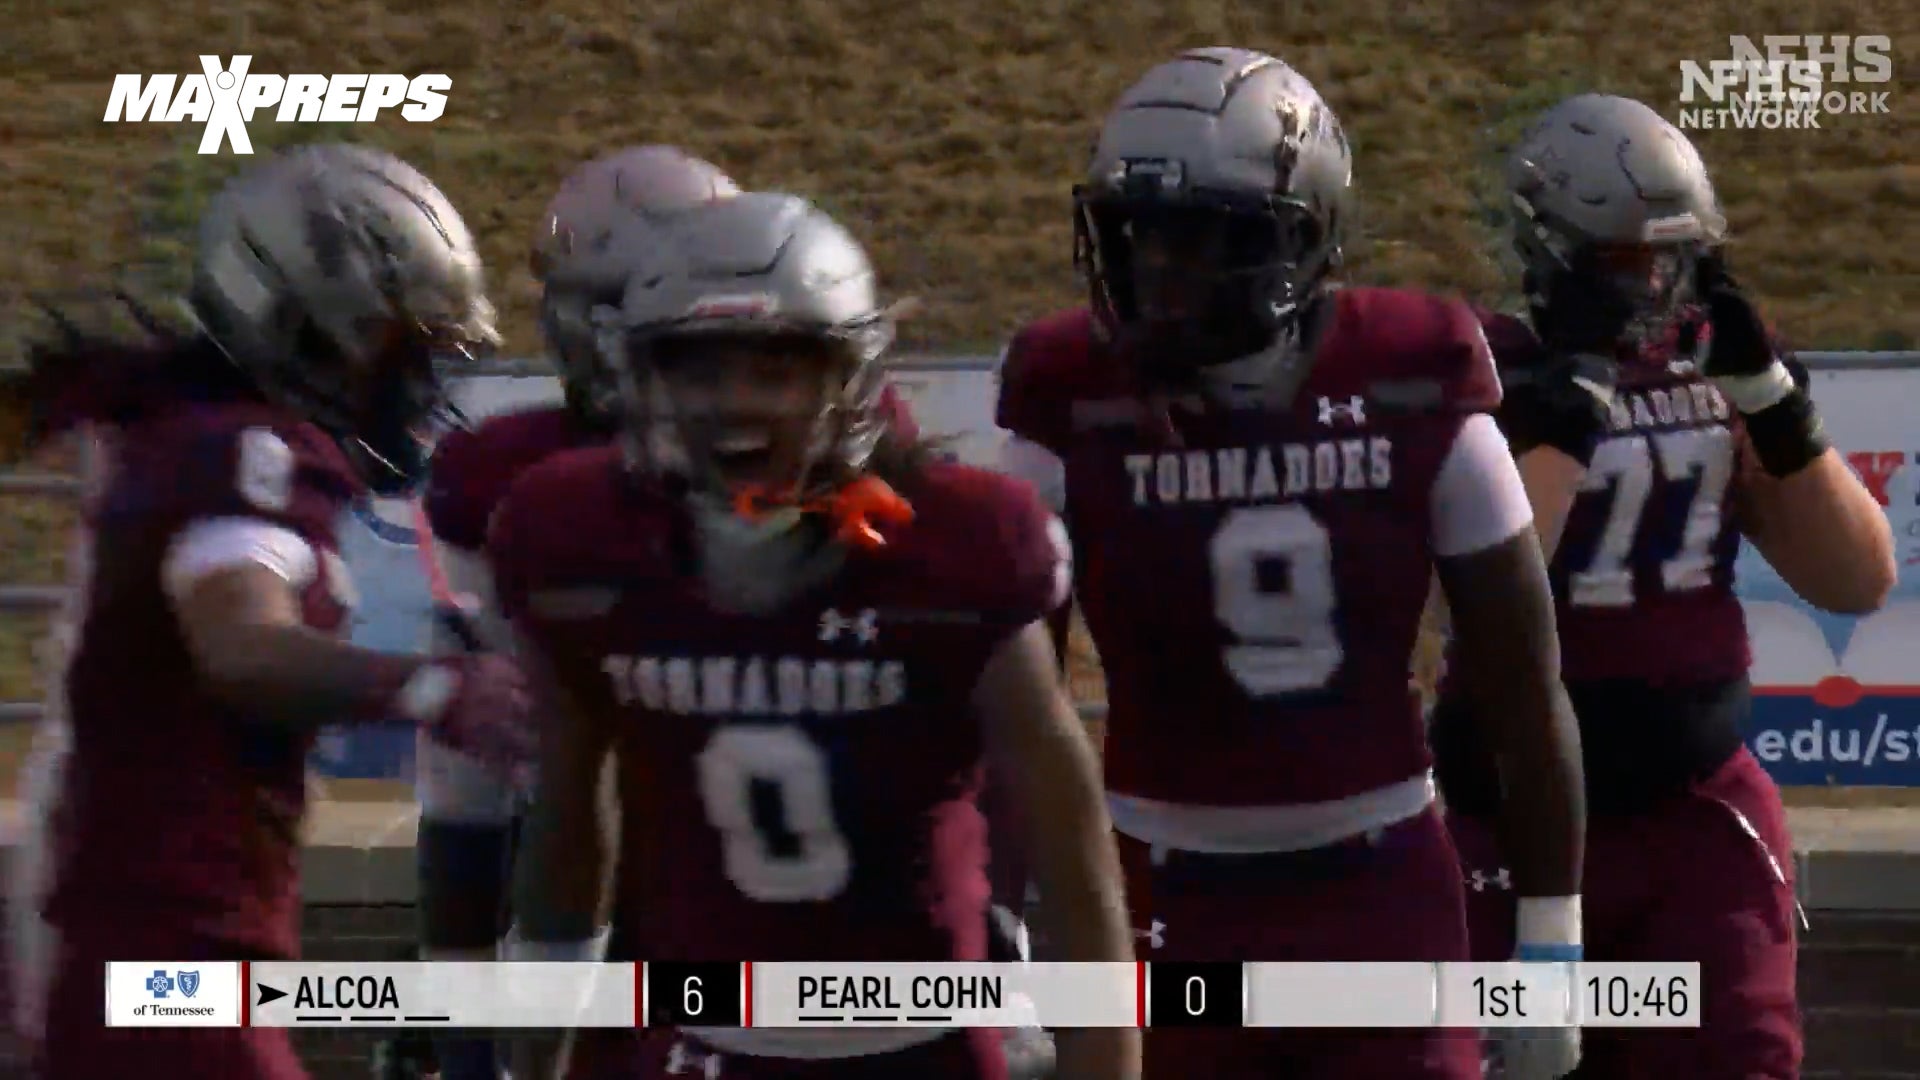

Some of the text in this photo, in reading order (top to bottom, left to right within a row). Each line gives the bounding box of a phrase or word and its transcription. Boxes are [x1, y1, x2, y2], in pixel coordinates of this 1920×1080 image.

[1209, 503, 1344, 696] 9
[1569, 424, 1734, 607] 77
[695, 726, 851, 902] 0
